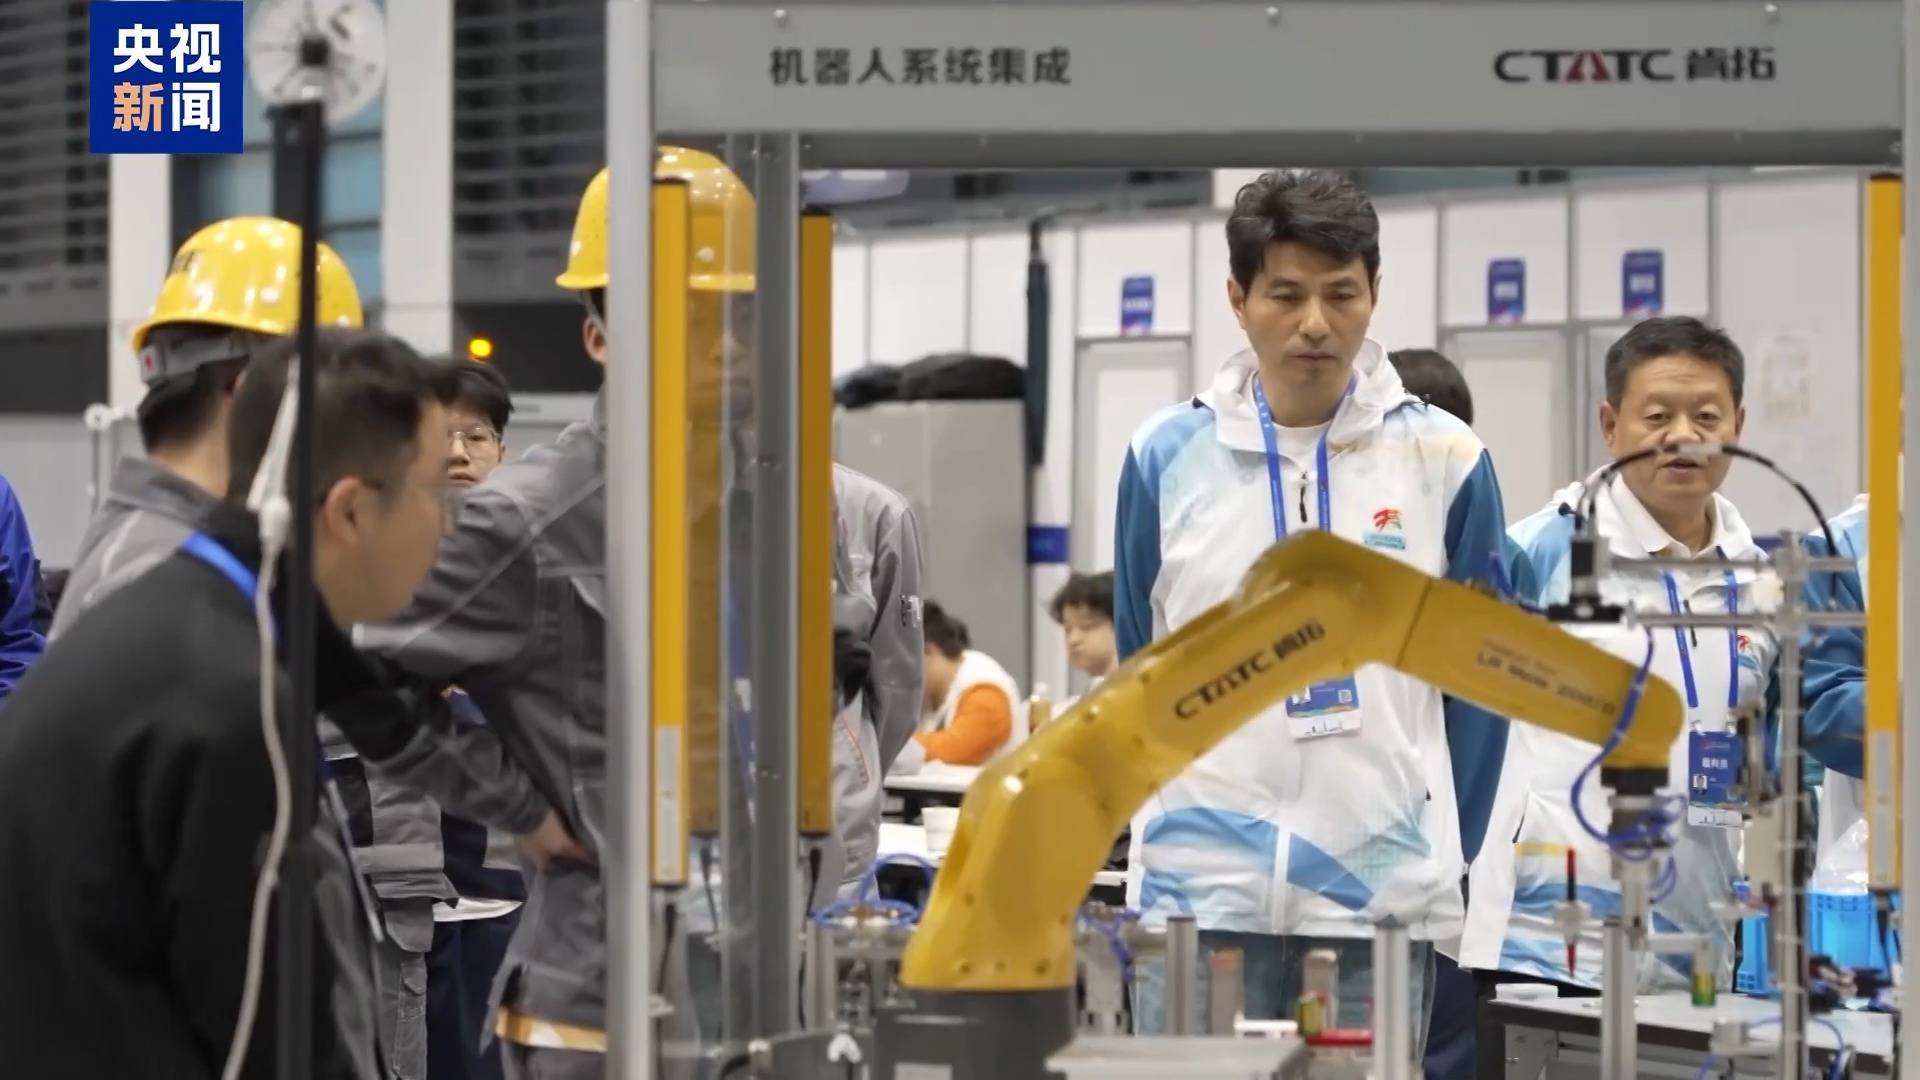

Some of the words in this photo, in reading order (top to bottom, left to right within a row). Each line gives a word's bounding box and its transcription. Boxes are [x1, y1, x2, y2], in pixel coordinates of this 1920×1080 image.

[770, 46, 1072, 85] 机器人系统集成
[1495, 49, 1675, 82] CTATC
[1175, 651, 1272, 719] CTATC
